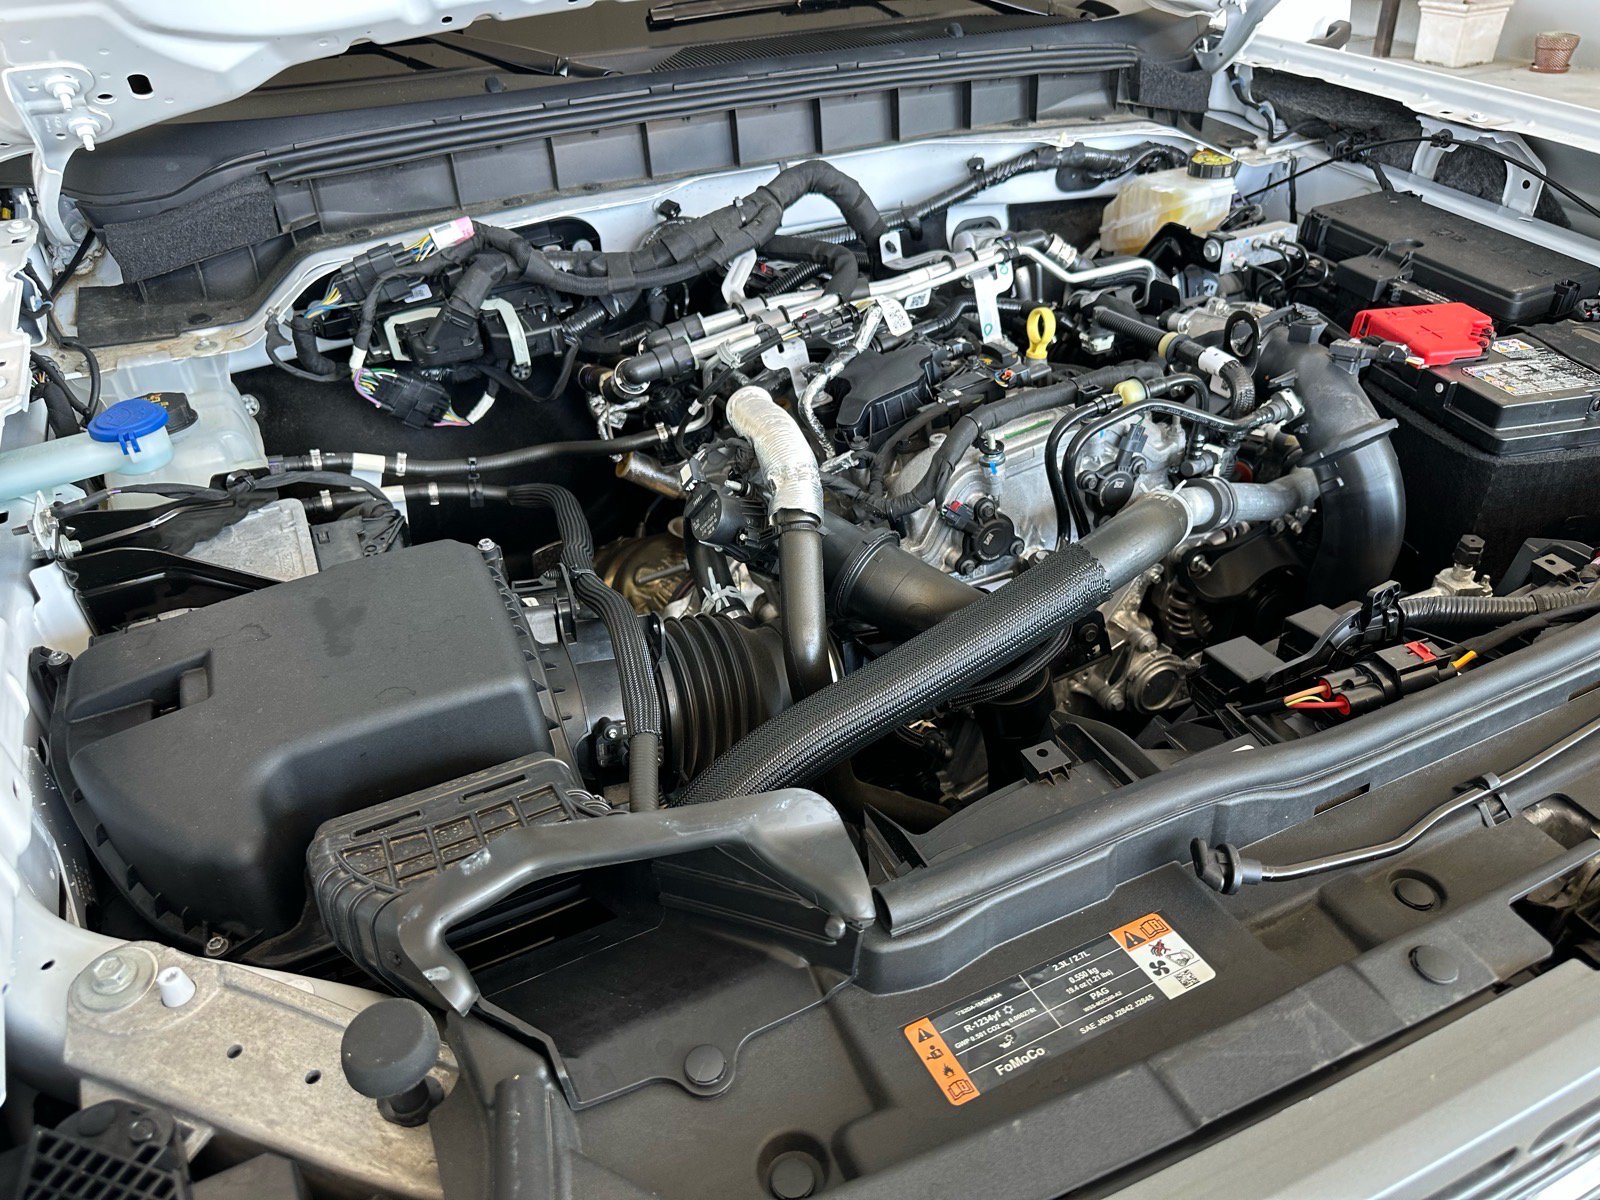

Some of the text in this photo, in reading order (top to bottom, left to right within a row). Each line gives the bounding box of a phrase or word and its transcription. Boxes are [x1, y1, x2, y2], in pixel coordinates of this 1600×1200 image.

[1052, 959, 1070, 971] 2.3L
[1072, 950, 1091, 962] 2.7L
[1068, 966, 1100, 984] 0.550 kg
[1079, 981, 1088, 989] oz
[1099, 968, 1114, 979] lbs)
[1089, 987, 1110, 1000] PAG
[963, 1010, 1002, 1033] R-1234yf
[1079, 993, 1155, 1034] SAE J639 J2842 J2845
[954, 1037, 970, 1049] GWP
[986, 1024, 1002, 1034] CO2
[1000, 1020, 1010, 1028] eq
[994, 1045, 1046, 1077] FoMoCo
